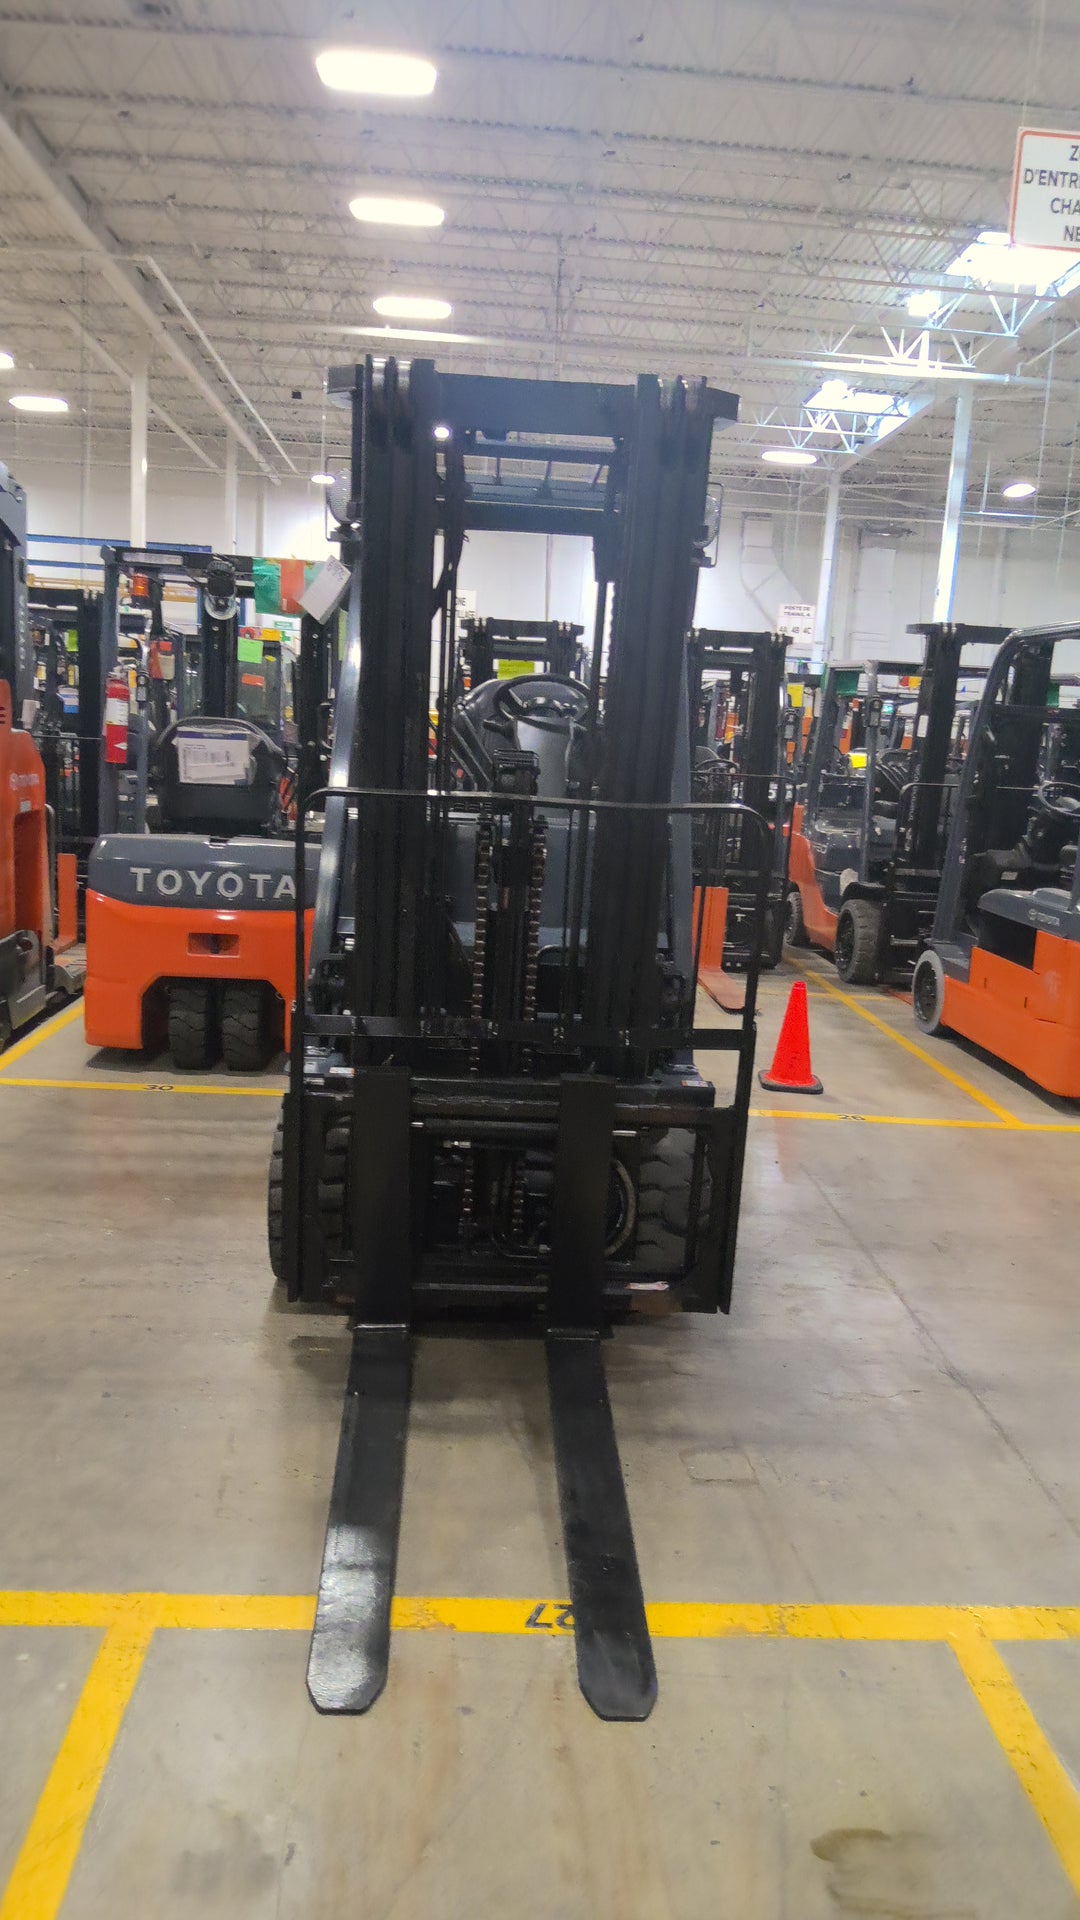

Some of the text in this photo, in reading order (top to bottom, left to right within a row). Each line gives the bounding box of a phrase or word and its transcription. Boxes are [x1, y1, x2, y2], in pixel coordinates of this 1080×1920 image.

[1069, 145, 1080, 161] Z
[1023, 168, 1080, 190] D'ENTR
[130, 867, 297, 900] TOYOTA
[525, 1603, 575, 1630] 27
